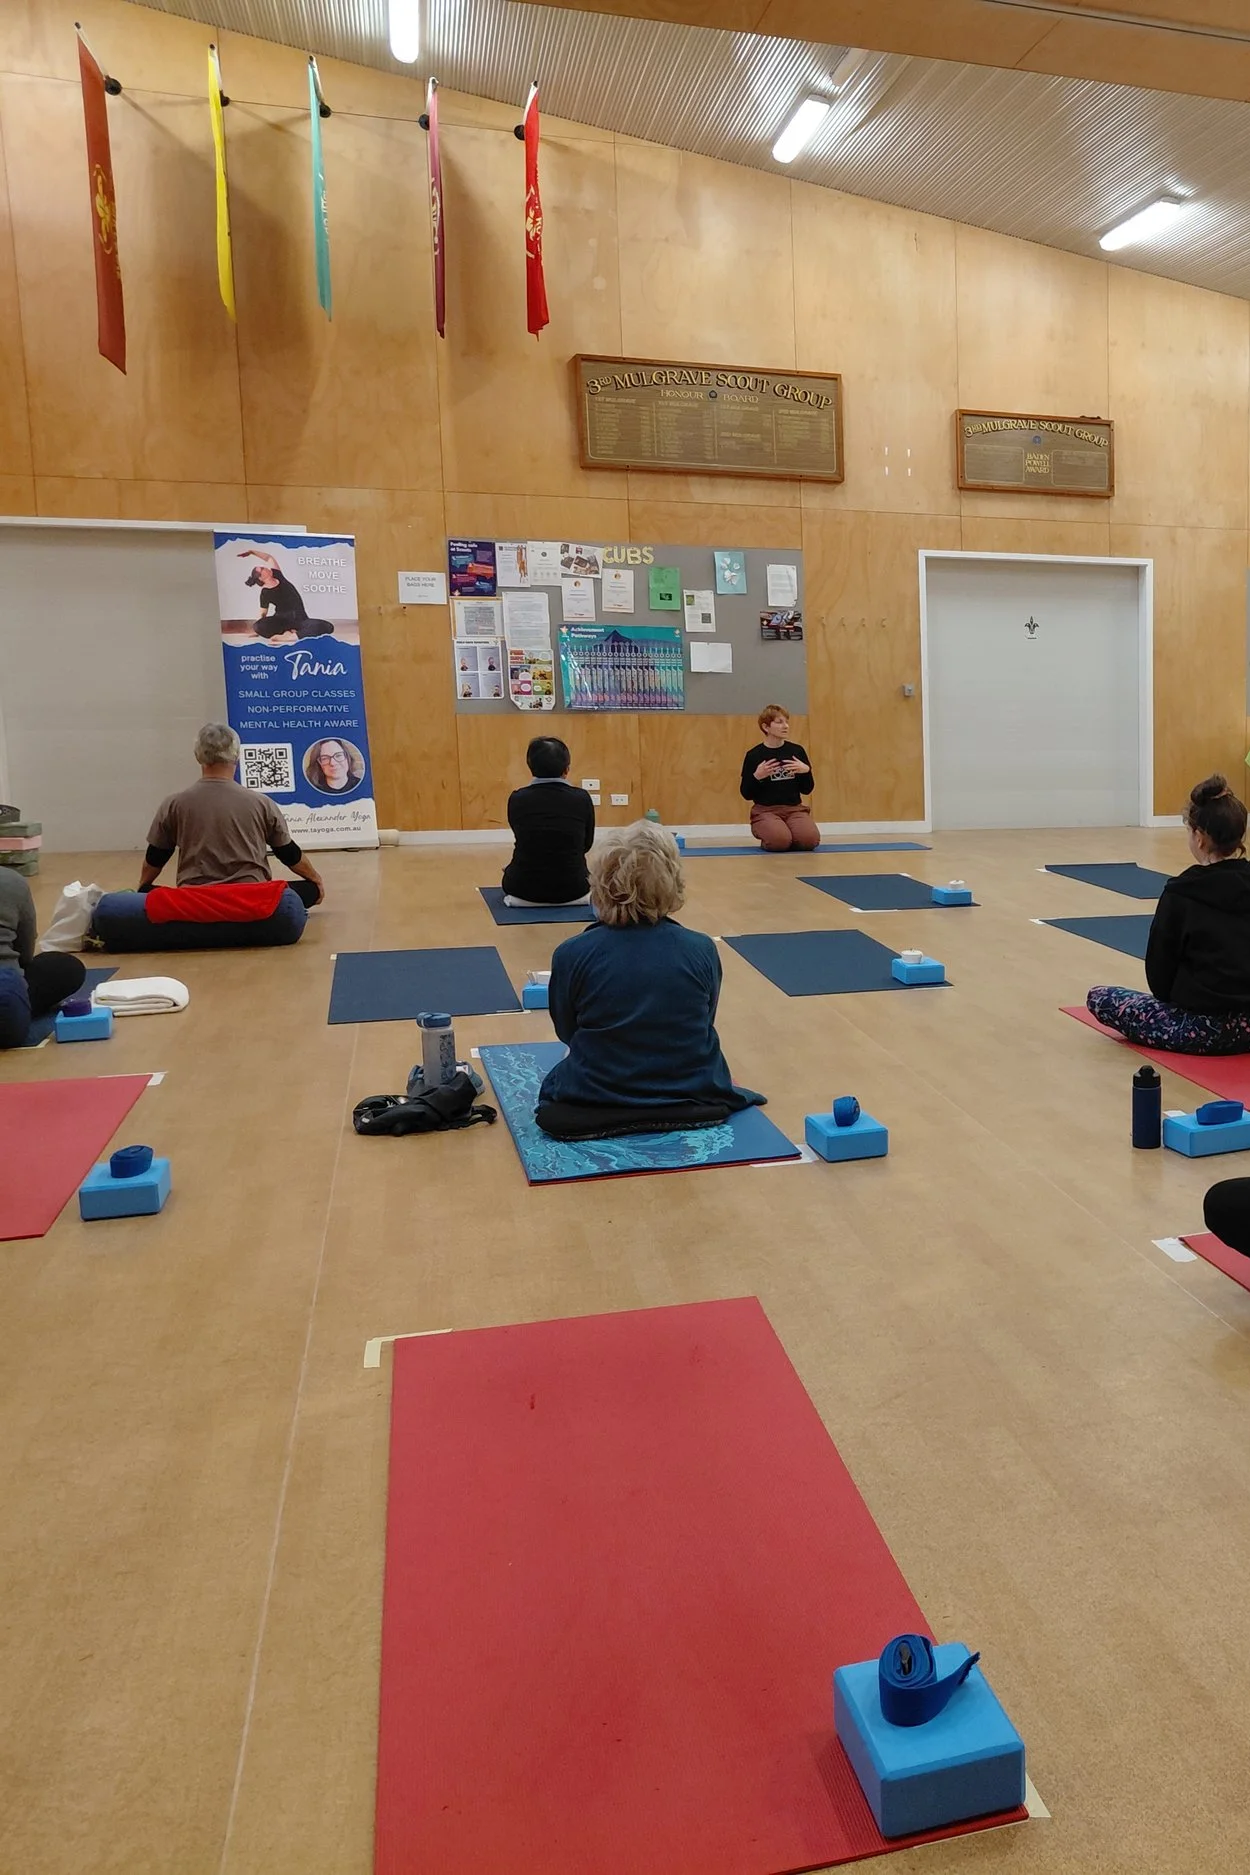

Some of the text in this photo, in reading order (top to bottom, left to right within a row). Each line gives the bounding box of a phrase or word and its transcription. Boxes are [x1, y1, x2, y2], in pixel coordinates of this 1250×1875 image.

[614, 370, 712, 391] MULGRAVE
[716, 372, 770, 393] SCOUT
[773, 383, 833, 410] GROUP
[660, 390, 759, 404] HONOUR BOARD
[982, 420, 1037, 434] MULGRAVE
[1038, 421, 1073, 436] SCOUT
[1075, 428, 1108, 448] GROUP
[1025, 466, 1050, 474] AWARD
[602, 546, 654, 564] CUBS
[297, 557, 347, 567] BREATHE
[309, 571, 339, 581] MOVE
[302, 585, 347, 594] SOOTHE
[241, 655, 276, 664] practise
[240, 664, 278, 672] your way
[284, 650, 348, 681] Tania
[251, 672, 269, 680] with
[238, 690, 356, 699] SMALL GROUP CLASSES
[248, 704, 349, 713] NON-PERFORMATIVE
[240, 720, 359, 729] MENTAL HEALTH AWARE
[291, 826, 361, 834] www.tayoga.com.au
